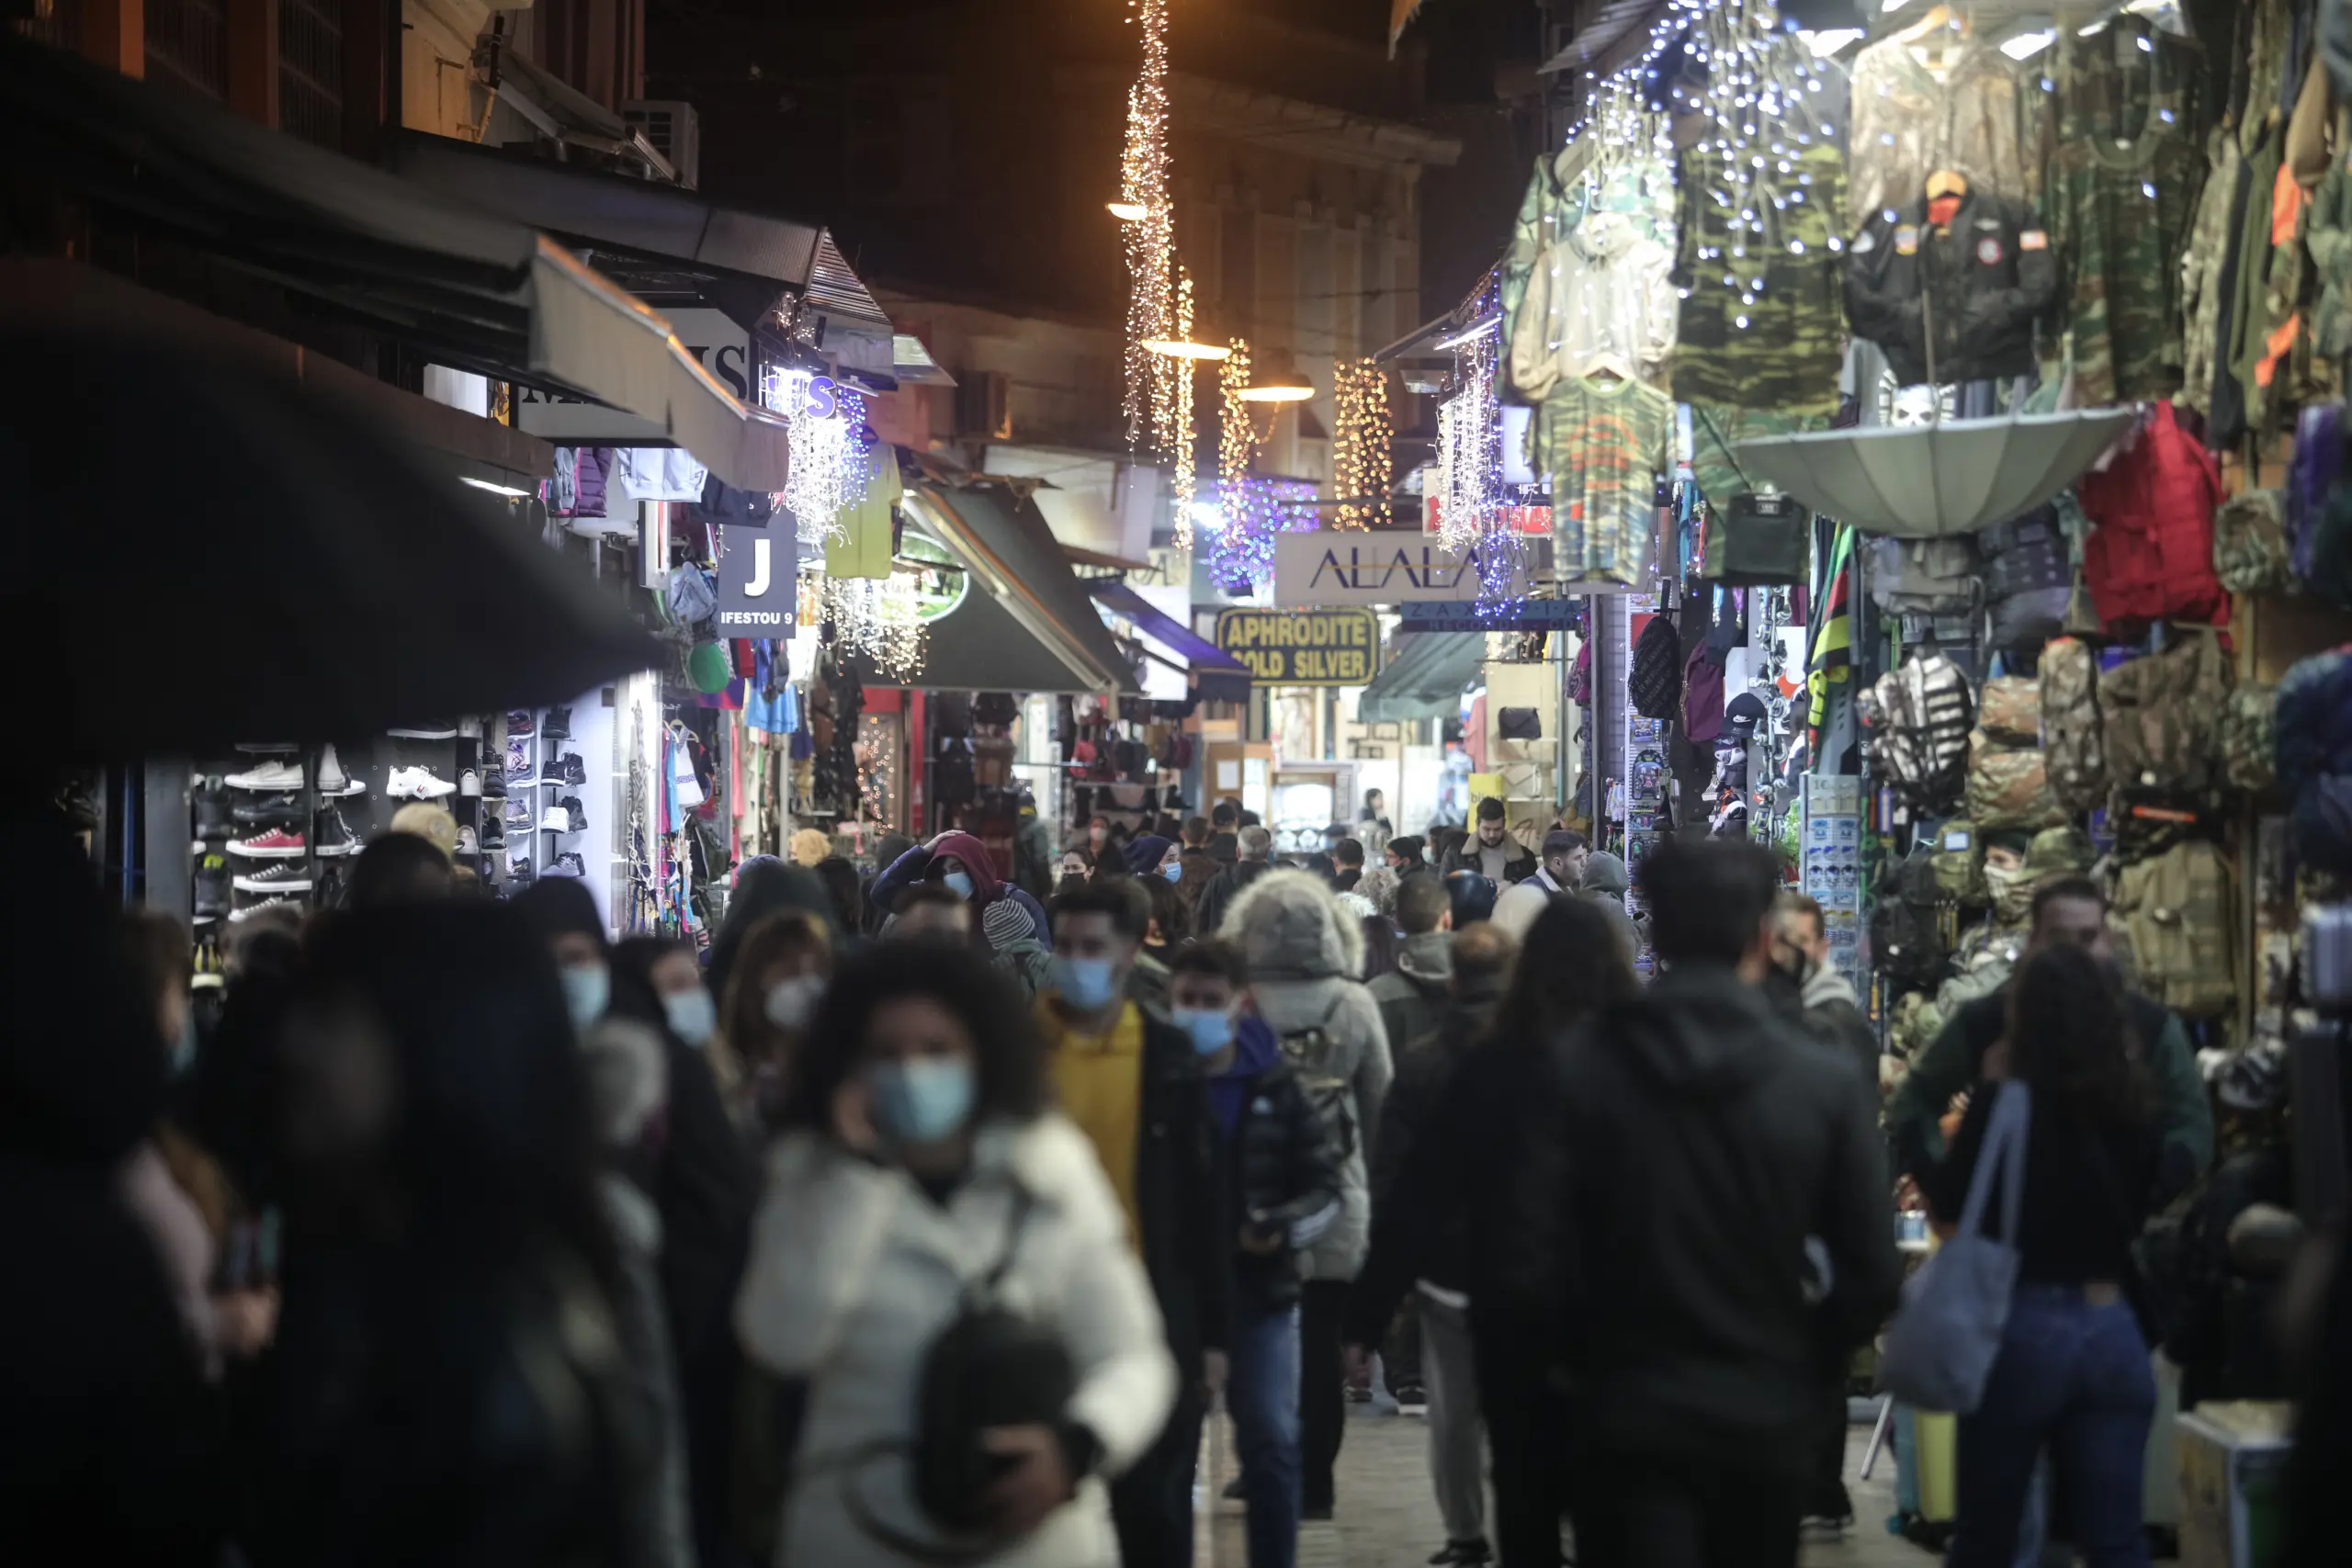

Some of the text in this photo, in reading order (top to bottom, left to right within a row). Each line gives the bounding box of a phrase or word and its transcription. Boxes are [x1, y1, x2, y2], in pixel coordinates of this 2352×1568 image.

[744, 538, 771, 597] J
[720, 611, 794, 625] IFESTOU 9
[1227, 615, 1367, 647] APHRODITE
[1294, 650, 1366, 679] SILVER
